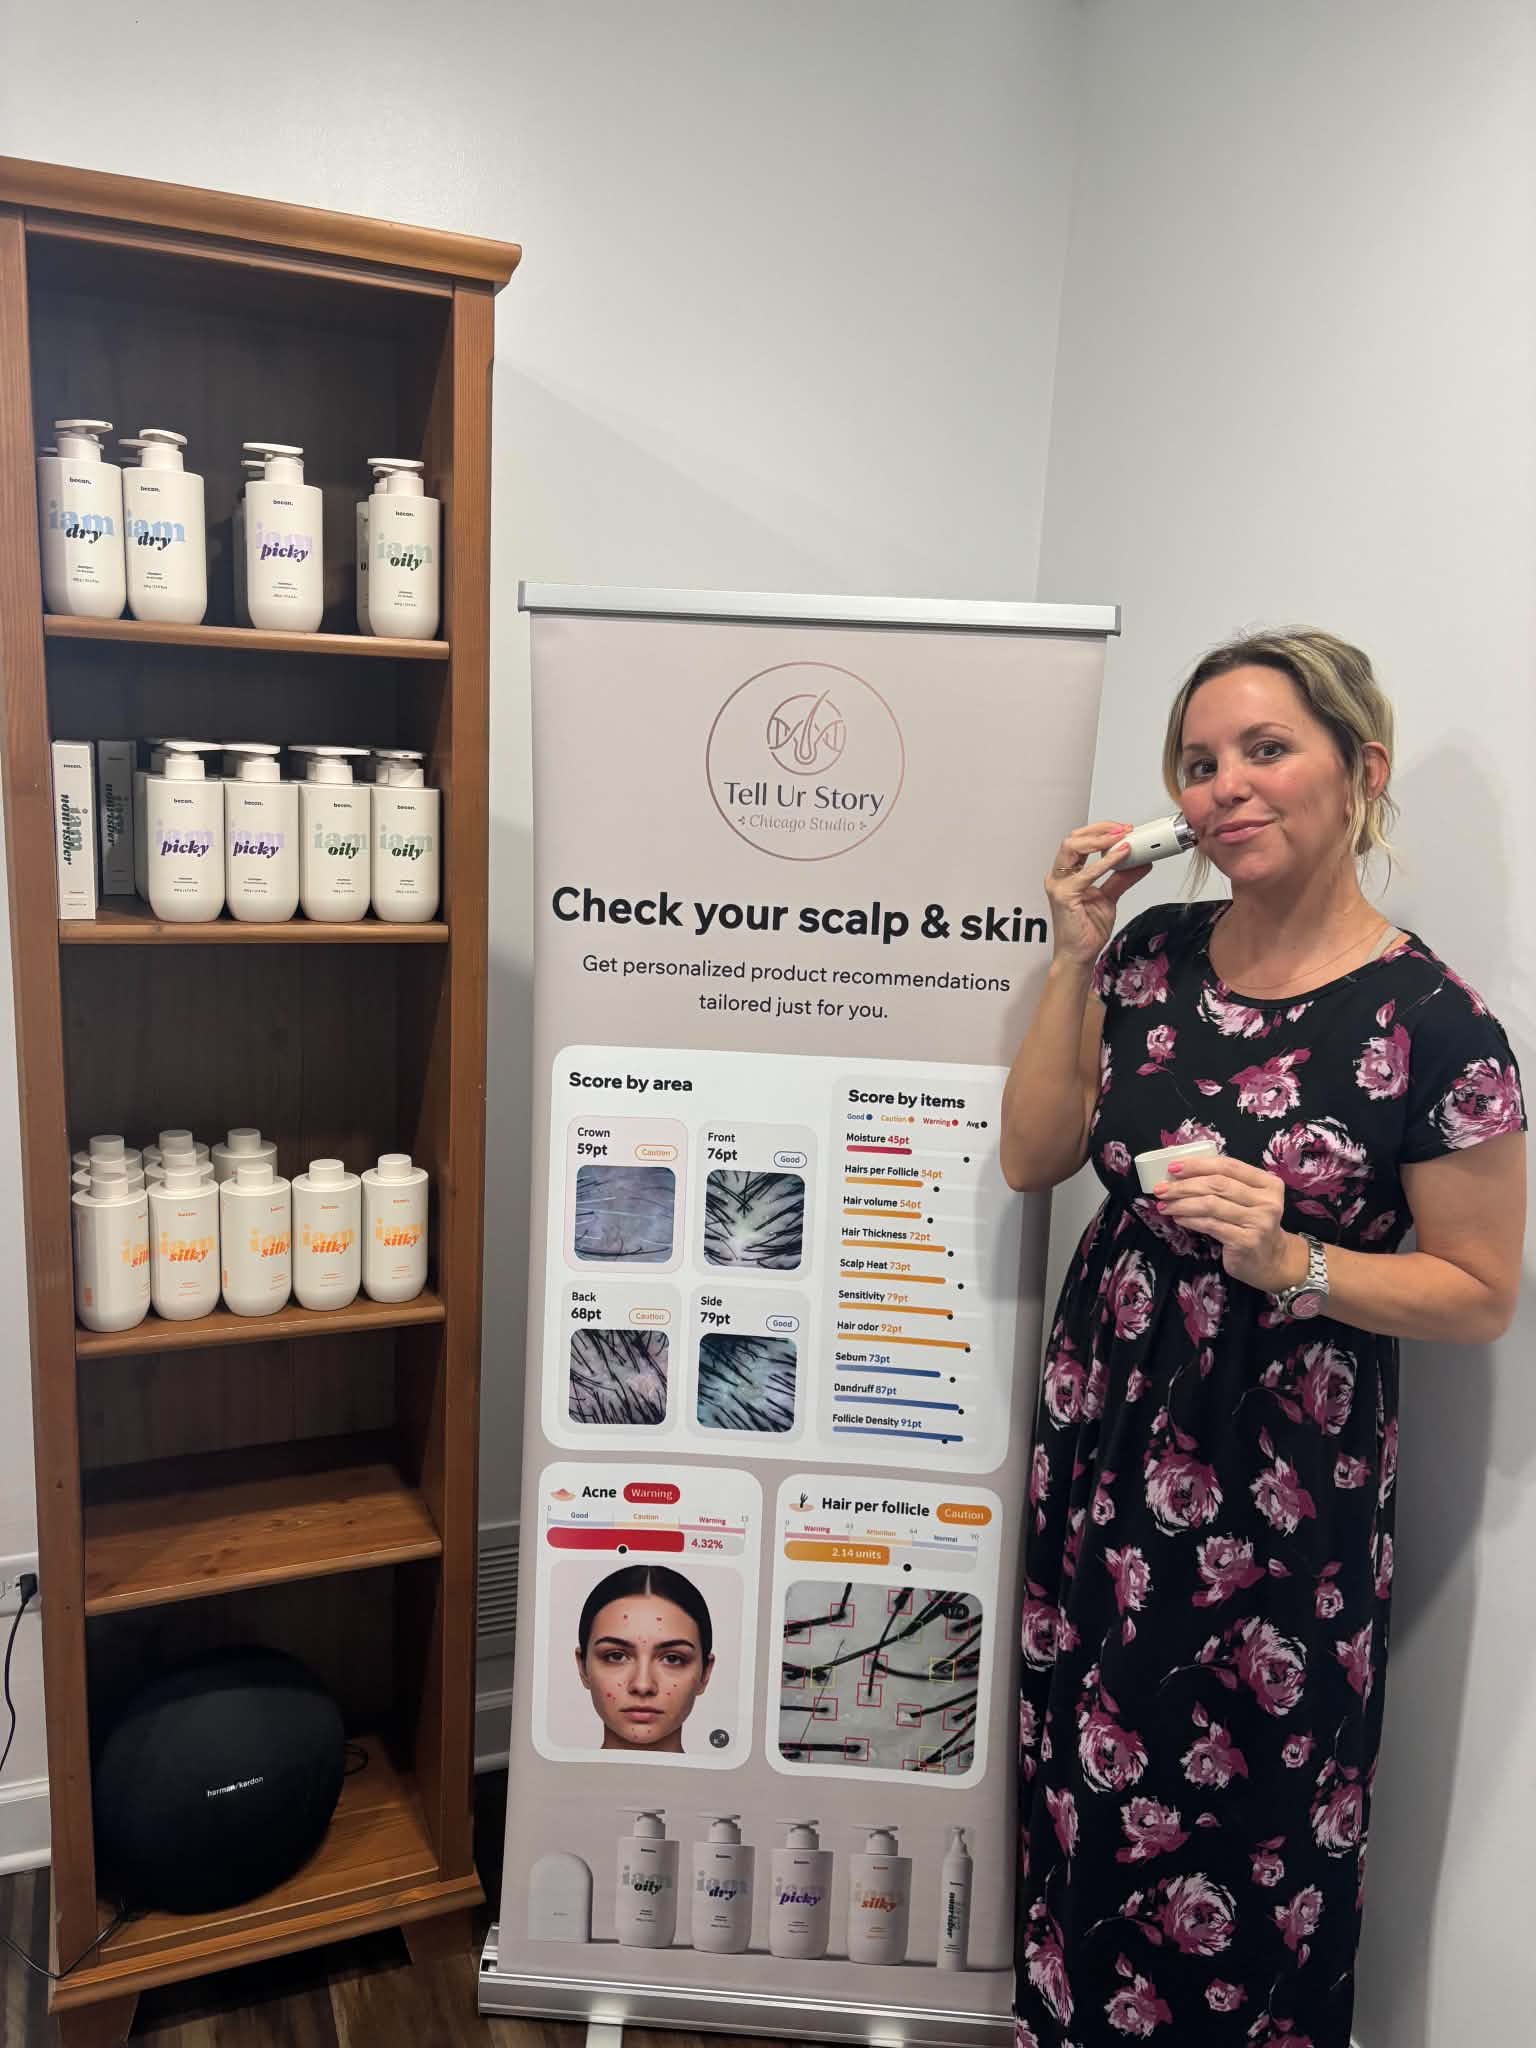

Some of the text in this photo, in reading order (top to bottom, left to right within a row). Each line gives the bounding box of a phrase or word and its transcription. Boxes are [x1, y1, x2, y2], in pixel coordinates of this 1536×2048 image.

[65, 524, 102, 544] dry
[137, 532, 172, 551] dry
[260, 542, 309, 563] picky
[390, 553, 423, 571] oily
[724, 782, 885, 817] Tell Ur Story
[61, 794, 73, 865] nourisher
[749, 814, 855, 832] Chicago Studio
[160, 840, 209, 857] picky
[232, 840, 279, 859] picky
[328, 842, 359, 859] oily
[391, 844, 424, 860] oily
[552, 887, 1048, 944] Check your scalp & skin
[582, 954, 1011, 992] Get personalized product recommendations
[698, 994, 889, 1020] tailored just for you.
[569, 1071, 693, 1093] Score by area
[848, 1089, 966, 1109] Score by items
[847, 1113, 980, 1129] Good Caution Warning Avg
[577, 1127, 610, 1138] Crown
[707, 1132, 736, 1143] Front
[846, 1133, 910, 1146] Moisture 45pt
[576, 1142, 671, 1158] 59pt Caution
[707, 1147, 800, 1164] 76pt Good
[844, 1165, 943, 1180] Hairs per Follicle 54pt
[843, 1196, 921, 1209] Hair volume 54pt
[384, 1232, 418, 1247] silky
[841, 1227, 931, 1243] Hair Thickness 72pt
[169, 1247, 208, 1263] silky
[312, 1239, 349, 1255] silky
[131, 1248, 149, 1268] sil
[840, 1258, 911, 1272] Scalp Heat 73pt
[571, 1291, 596, 1302] Back
[700, 1296, 723, 1307] Side
[838, 1289, 908, 1303] Sensitivity 79pt
[571, 1307, 665, 1323] 68pt Caution
[700, 1312, 793, 1328] 79pt Good
[837, 1321, 902, 1335] Hair odor 92pt
[835, 1352, 890, 1364] Sebum 73pt
[834, 1383, 897, 1395] Dandruff 87pt
[832, 1414, 922, 1429] Follicle Density 91pt
[582, 1486, 673, 1500] Acne Warning
[821, 1497, 984, 1520] Hair per follicle Caution
[633, 1513, 660, 1521] Caution
[699, 1516, 726, 1525] Warning
[804, 1525, 831, 1534] Warning
[691, 1538, 723, 1550] 4.32%
[831, 1548, 882, 1560] 2.14 units
[634, 1881, 662, 1895] oily
[709, 1886, 737, 1900] dry
[779, 1892, 822, 1906] picky
[861, 1896, 897, 1912] silky
